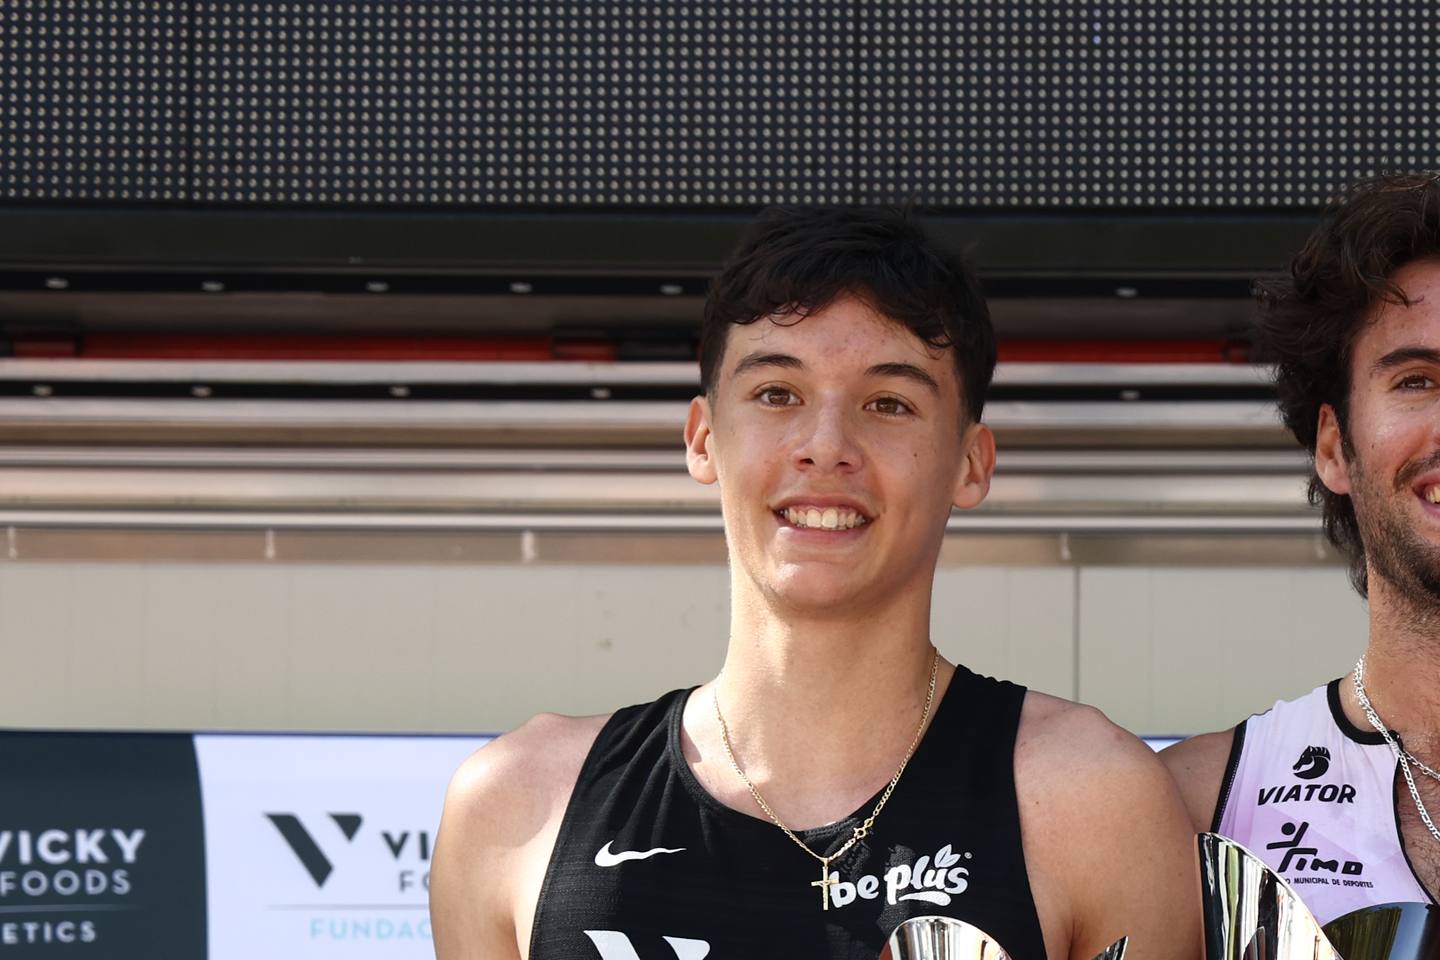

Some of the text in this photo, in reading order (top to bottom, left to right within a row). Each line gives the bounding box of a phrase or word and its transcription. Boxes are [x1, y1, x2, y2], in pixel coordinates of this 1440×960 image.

[1257, 784, 1356, 806] VIATOR
[883, 848, 970, 907] plus
[1293, 877, 1330, 886] MUNICIPAL
[1343, 880, 1375, 889] DEPORTES
[1, 920, 97, 944] ETICS
[309, 917, 432, 941] FUNDAC
